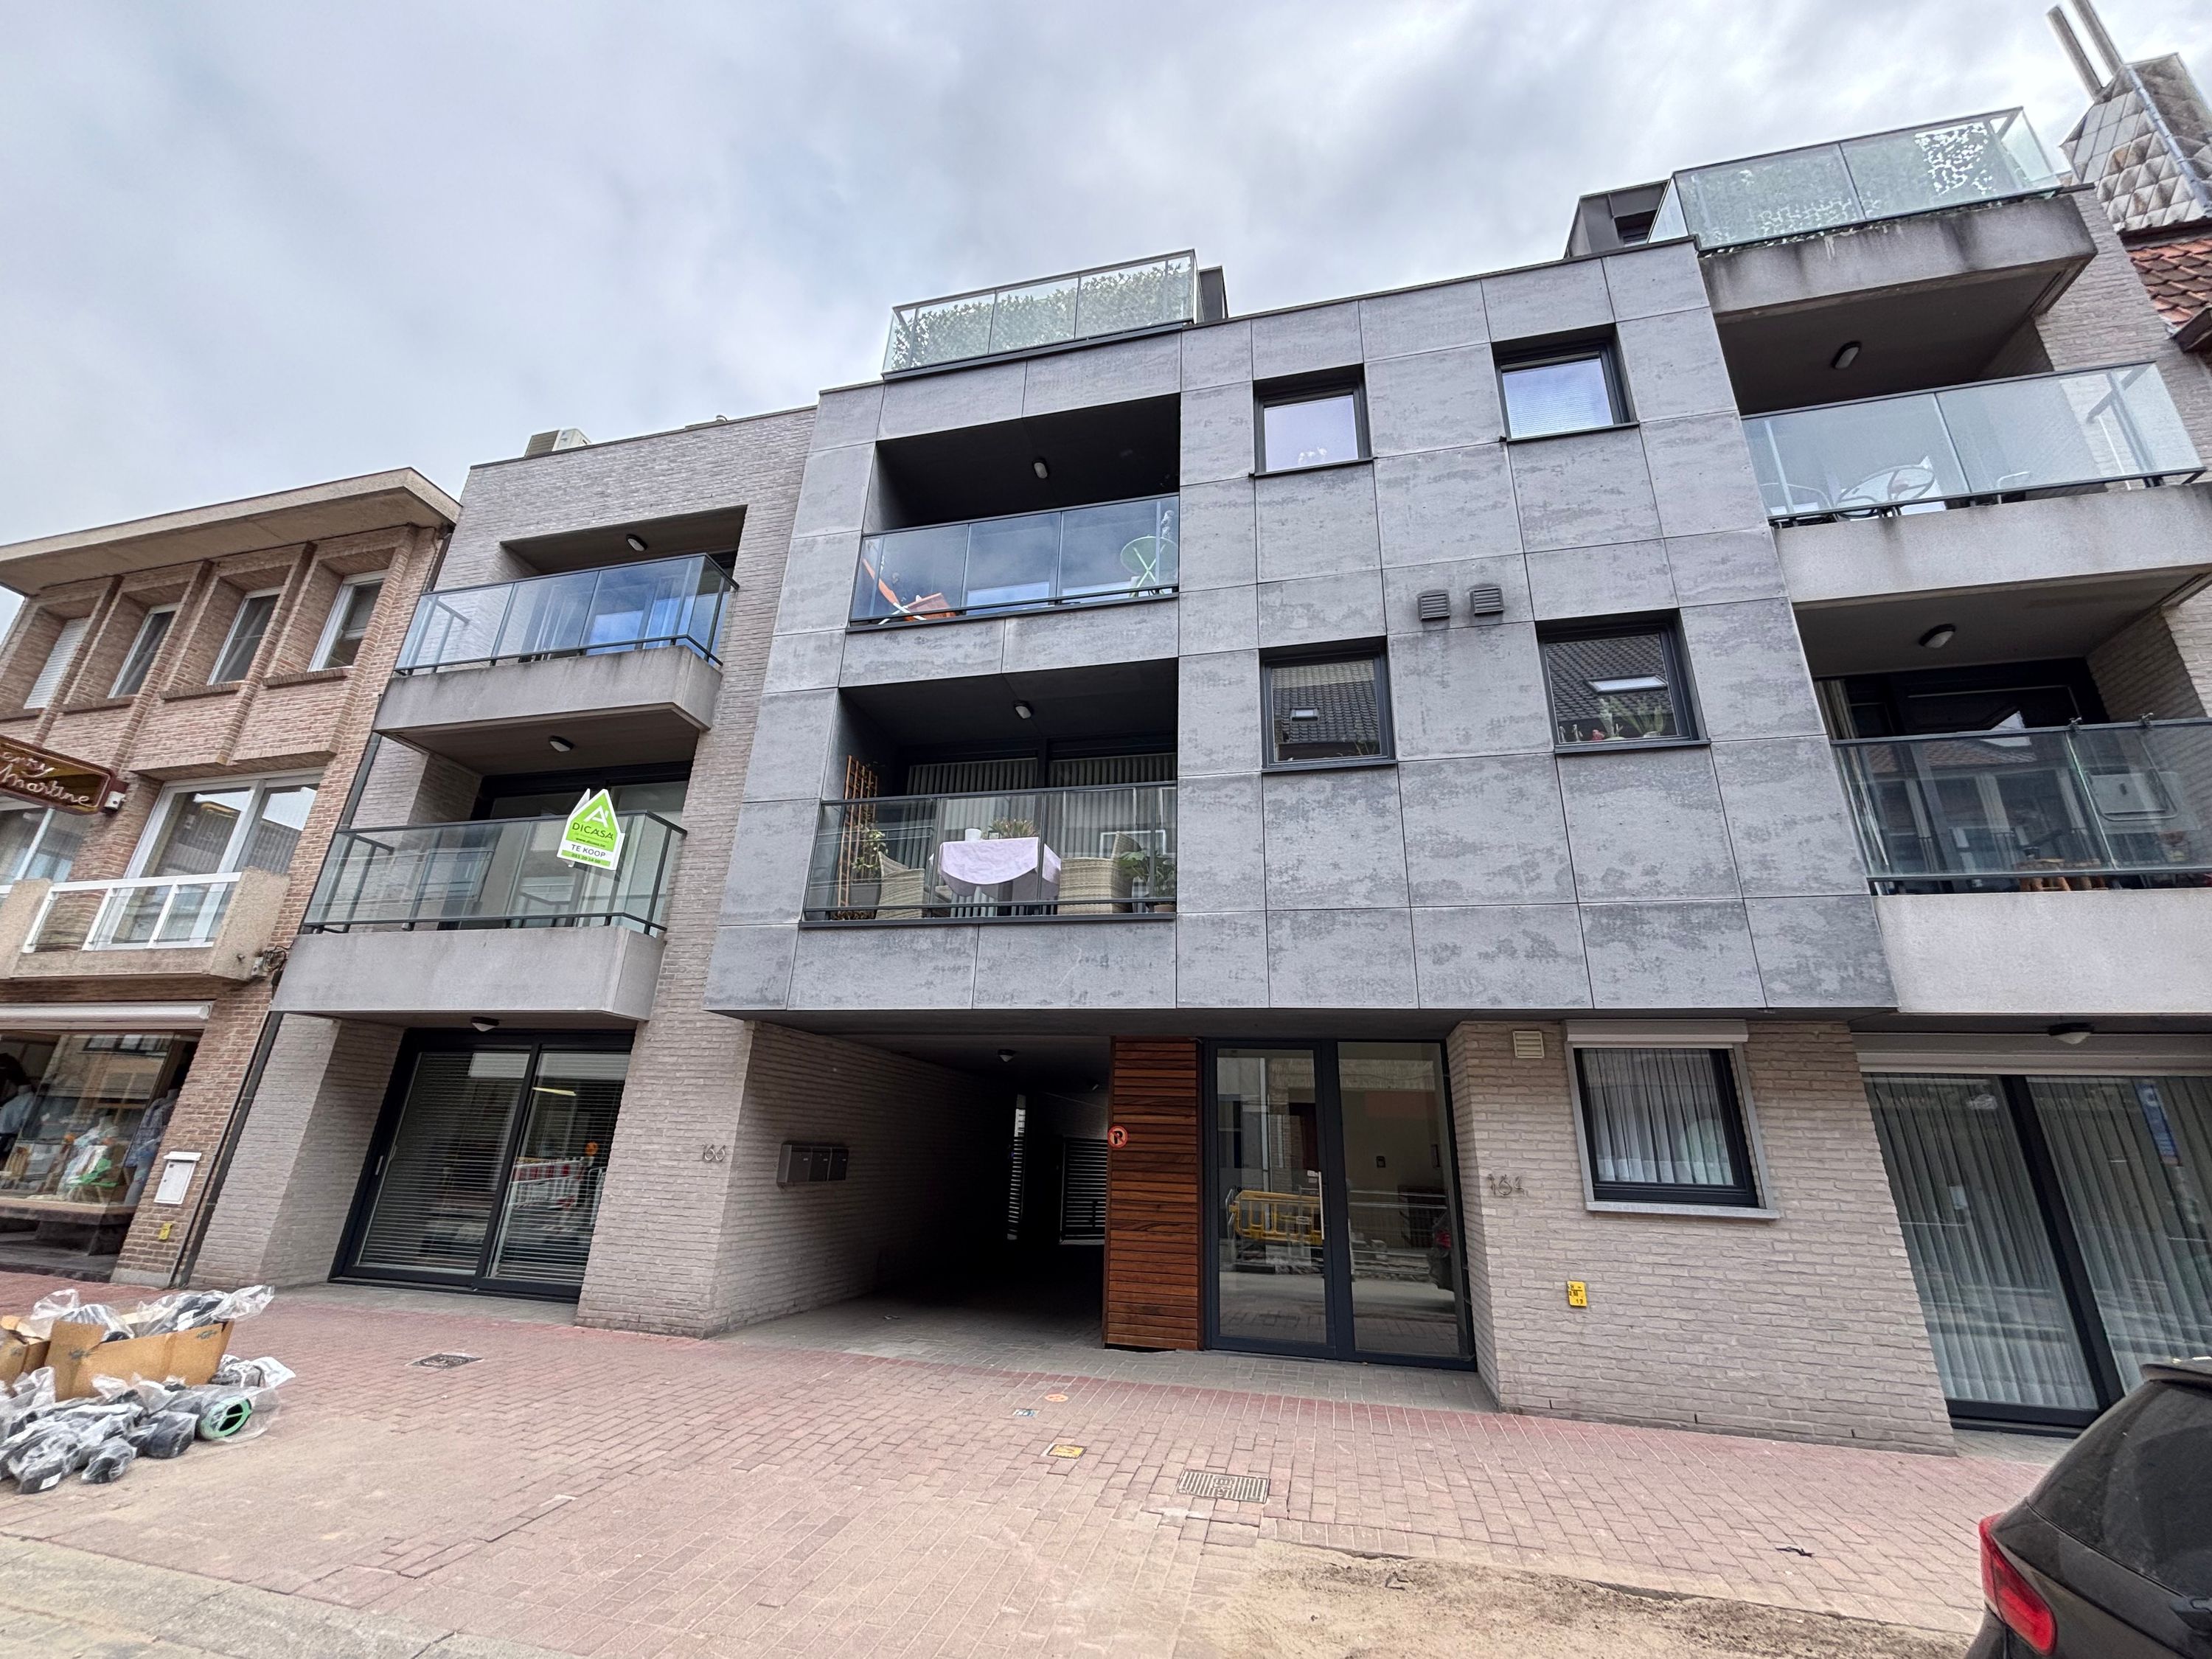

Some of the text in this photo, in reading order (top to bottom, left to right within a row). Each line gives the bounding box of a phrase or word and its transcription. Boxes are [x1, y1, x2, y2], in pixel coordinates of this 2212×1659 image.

[572, 822, 613, 841] DICASA
[571, 844, 606, 858] TE KOOP
